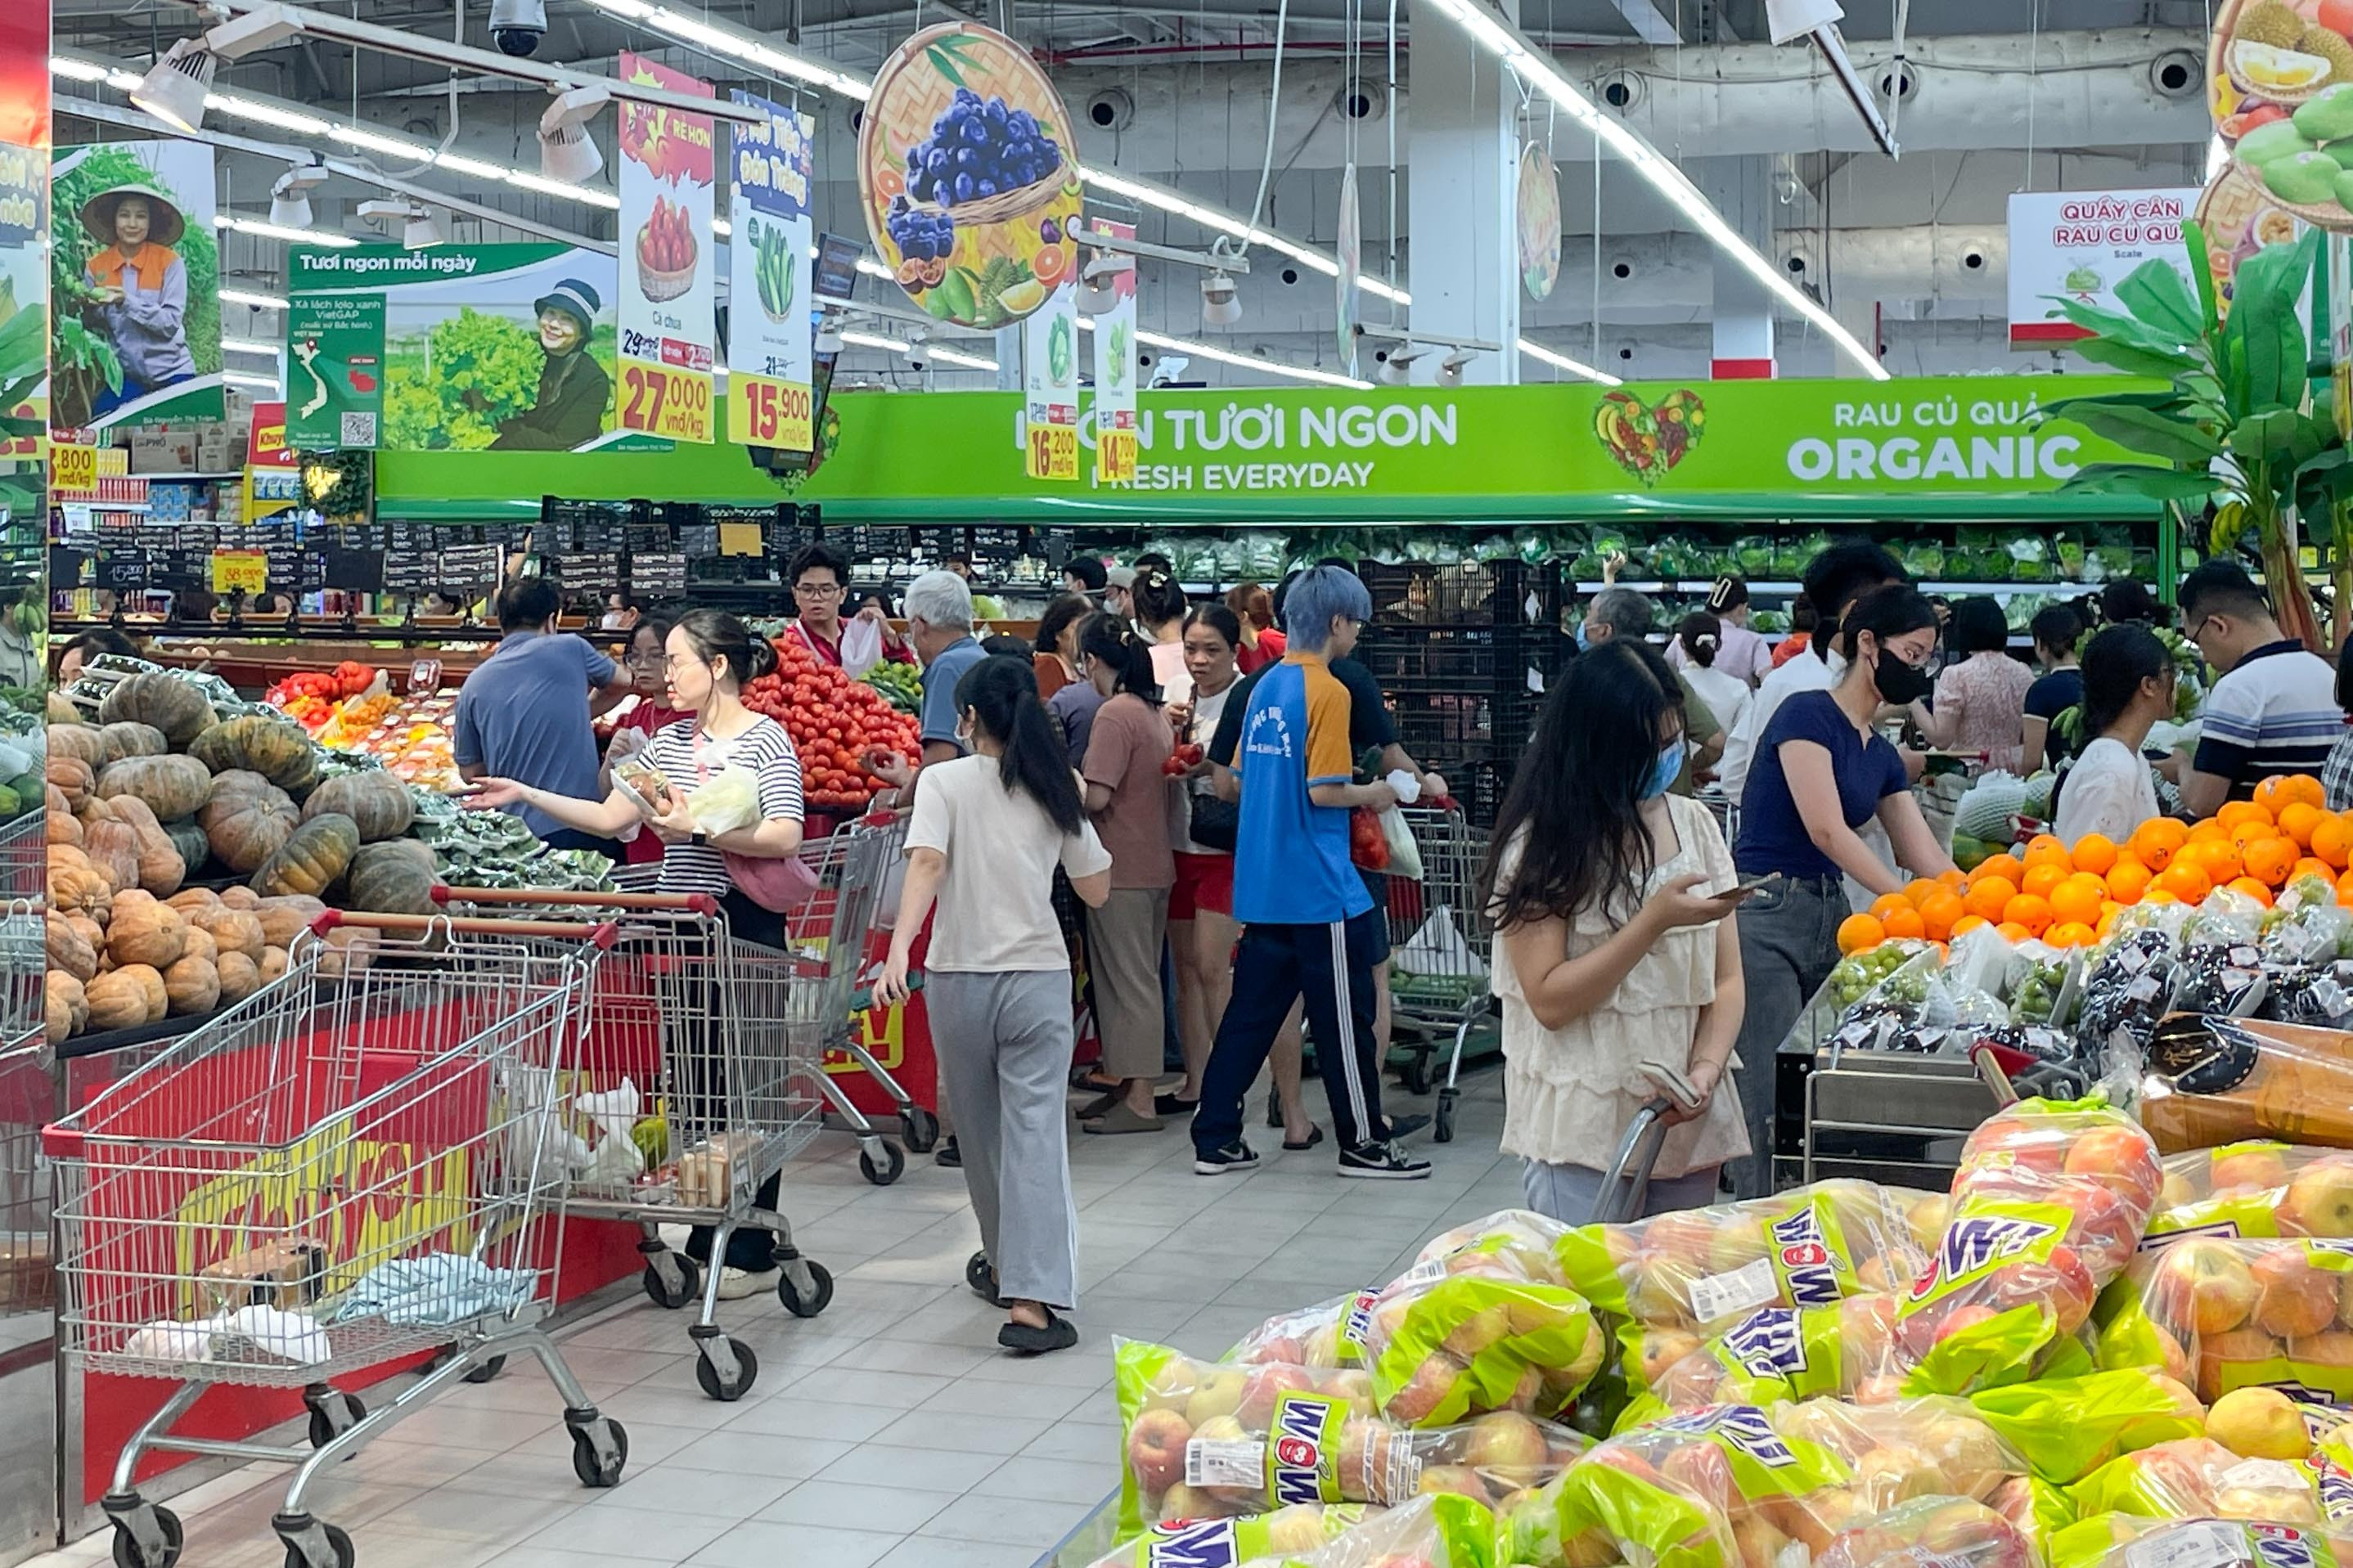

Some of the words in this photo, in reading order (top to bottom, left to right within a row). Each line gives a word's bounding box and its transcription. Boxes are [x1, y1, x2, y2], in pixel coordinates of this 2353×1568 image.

[2134, 195, 2182, 218] CÂN
[2056, 227, 2101, 245] RAU
[2108, 220, 2139, 243] CỦ
[2145, 224, 2185, 242] QU
[299, 254, 340, 270] Tươi
[344, 257, 390, 272] ngon
[393, 251, 428, 270] mỗi
[431, 254, 477, 273] ngày
[2114, 249, 2143, 258] Scale
[1835, 402, 1901, 427] RAU
[1914, 395, 1959, 426] CỦ
[1165, 402, 1284, 451] TƯƠI
[1301, 403, 1457, 448] NGON
[1788, 435, 2081, 481] ORGANIC
[1203, 461, 1374, 490] EVERYDAY
